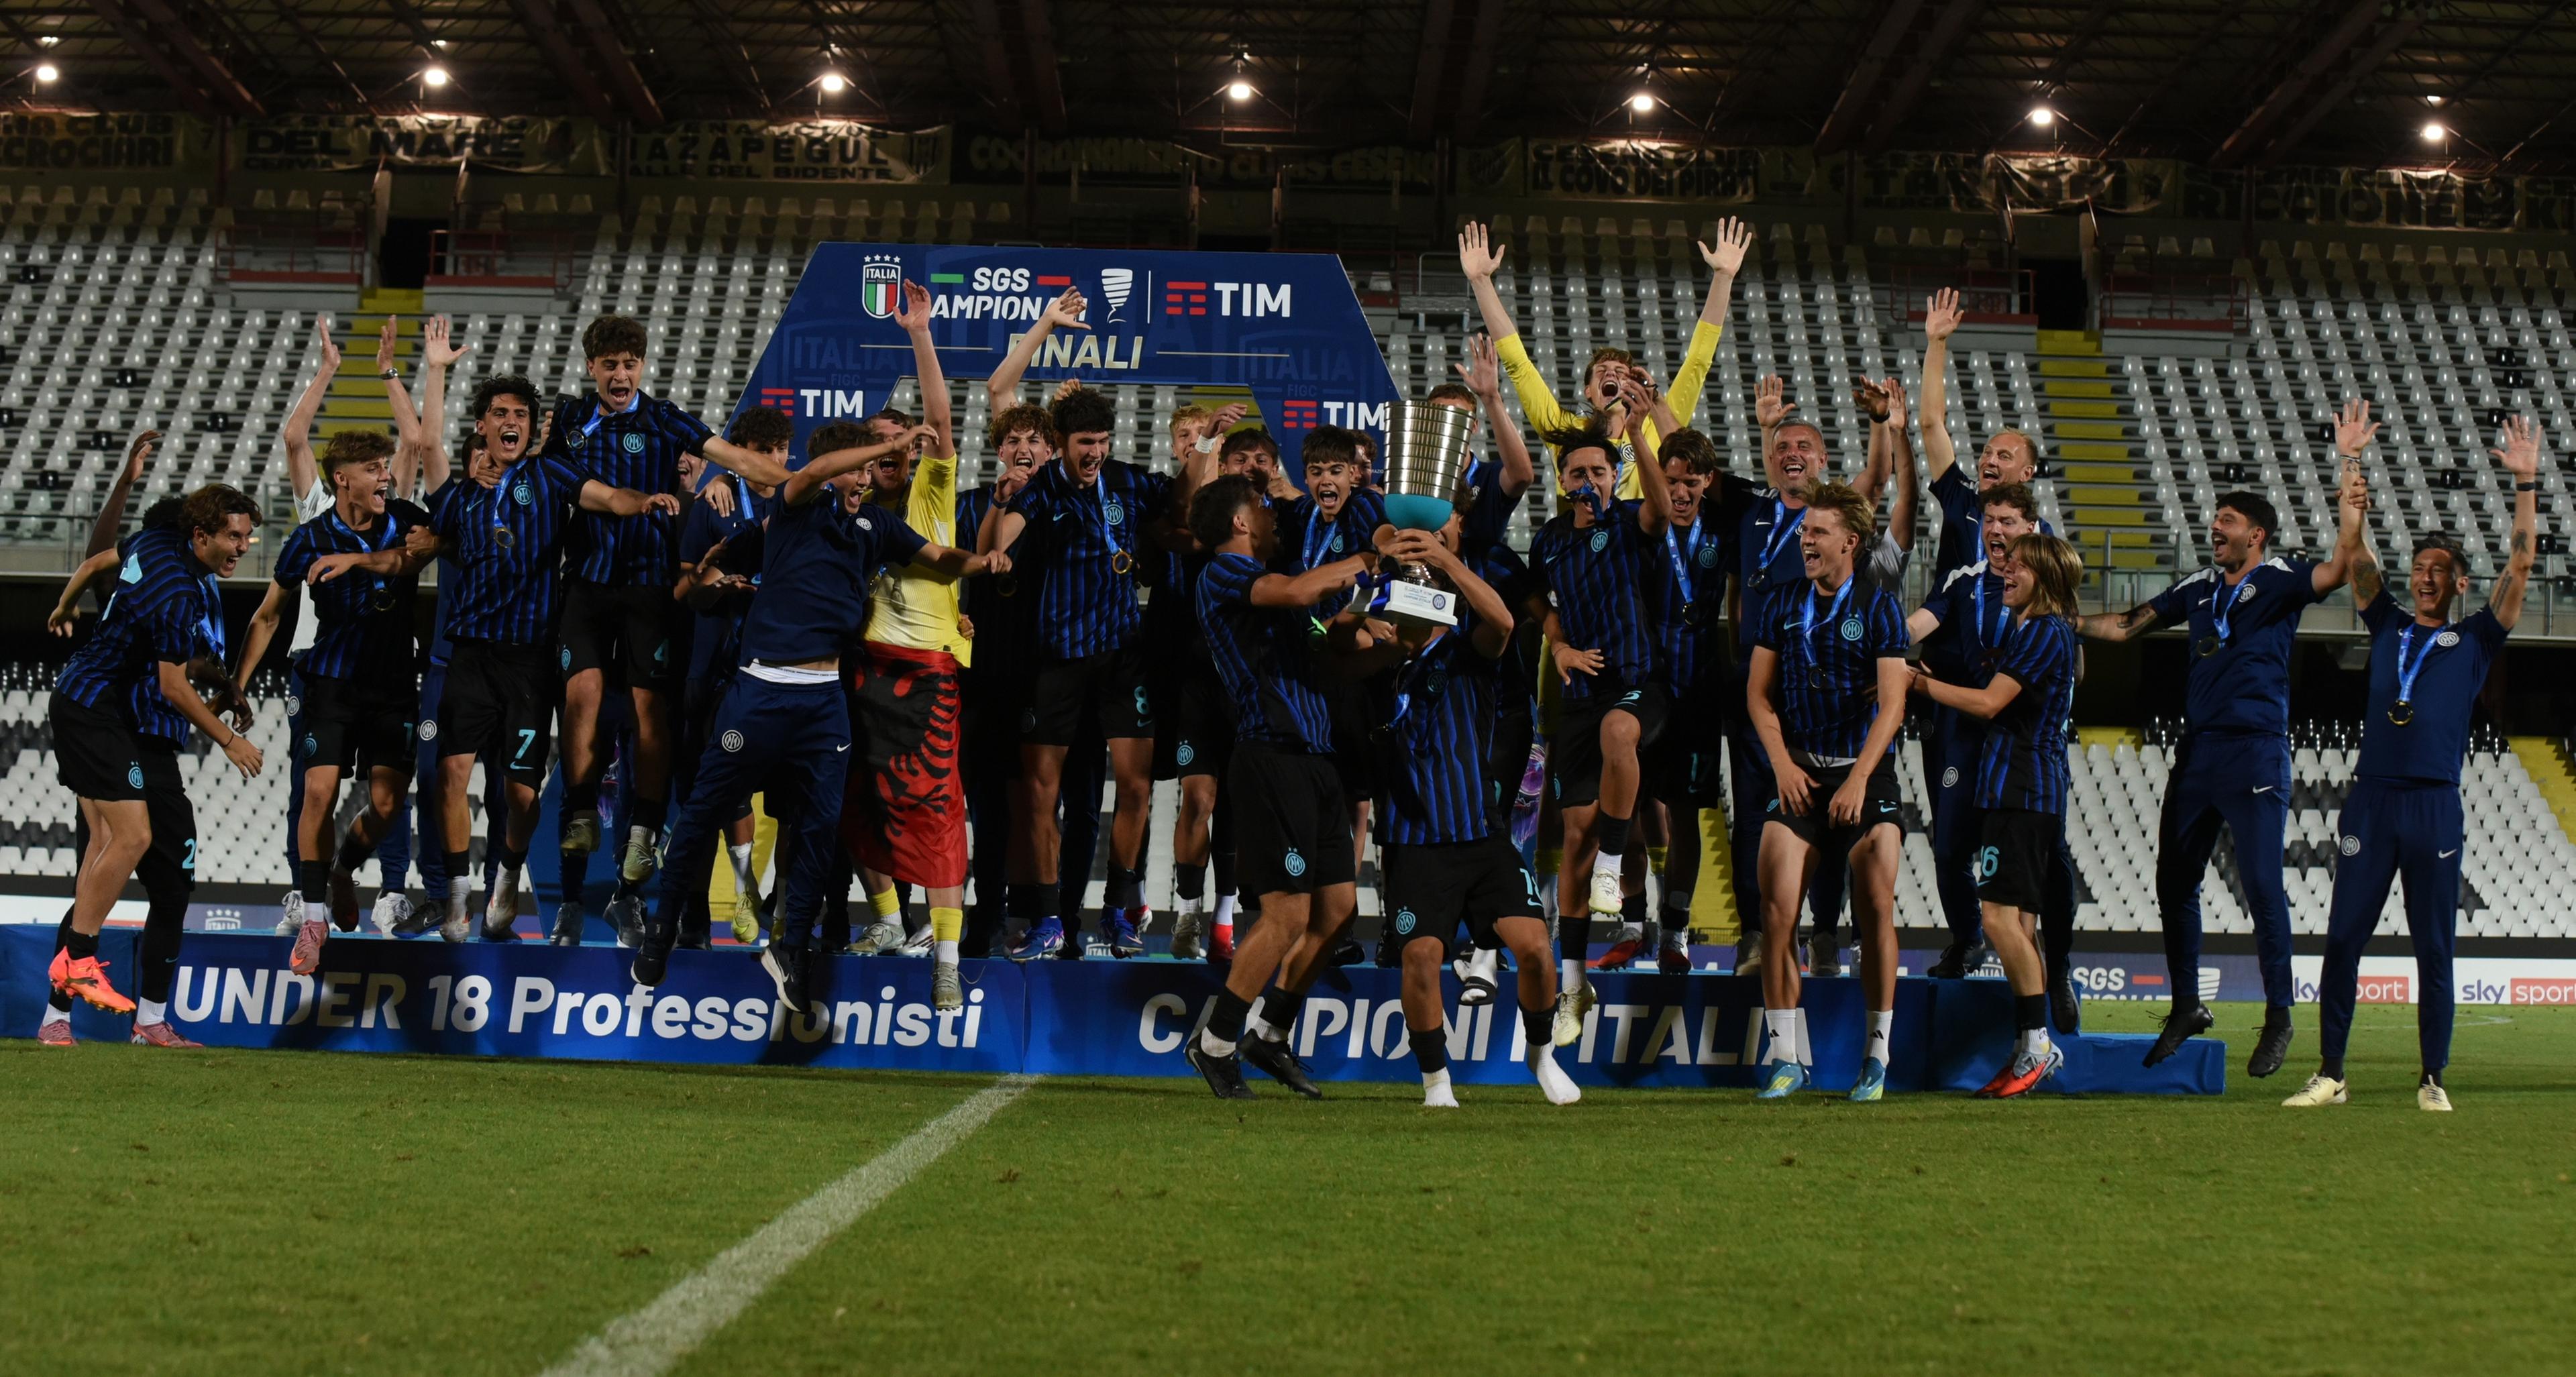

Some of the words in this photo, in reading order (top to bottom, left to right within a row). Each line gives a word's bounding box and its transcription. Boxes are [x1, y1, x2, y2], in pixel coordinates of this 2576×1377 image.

[247, 131, 351, 155] DEL
[370, 131, 526, 157] MARE
[708, 165, 761, 178] DEL
[773, 166, 892, 180] BIDENTE
[1560, 164, 1629, 195] COVO
[1634, 166, 1676, 197] DEI
[866, 268, 897, 278] ITALIA
[973, 268, 1030, 291] SGS
[1214, 282, 1291, 317] TIM
[800, 389, 863, 417] TIM
[1324, 401, 1386, 431] TIM
[654, 638, 669, 669] 4
[1134, 685, 1149, 715] 8
[516, 728, 536, 760] 7
[2072, 967, 2125, 991] SGS
[2462, 979, 2506, 1004] sky
[2516, 985, 2576, 1004] spor
[174, 967, 407, 1030] UNDER
[428, 975, 492, 1032] 18
[508, 977, 984, 1048] Professionisti
